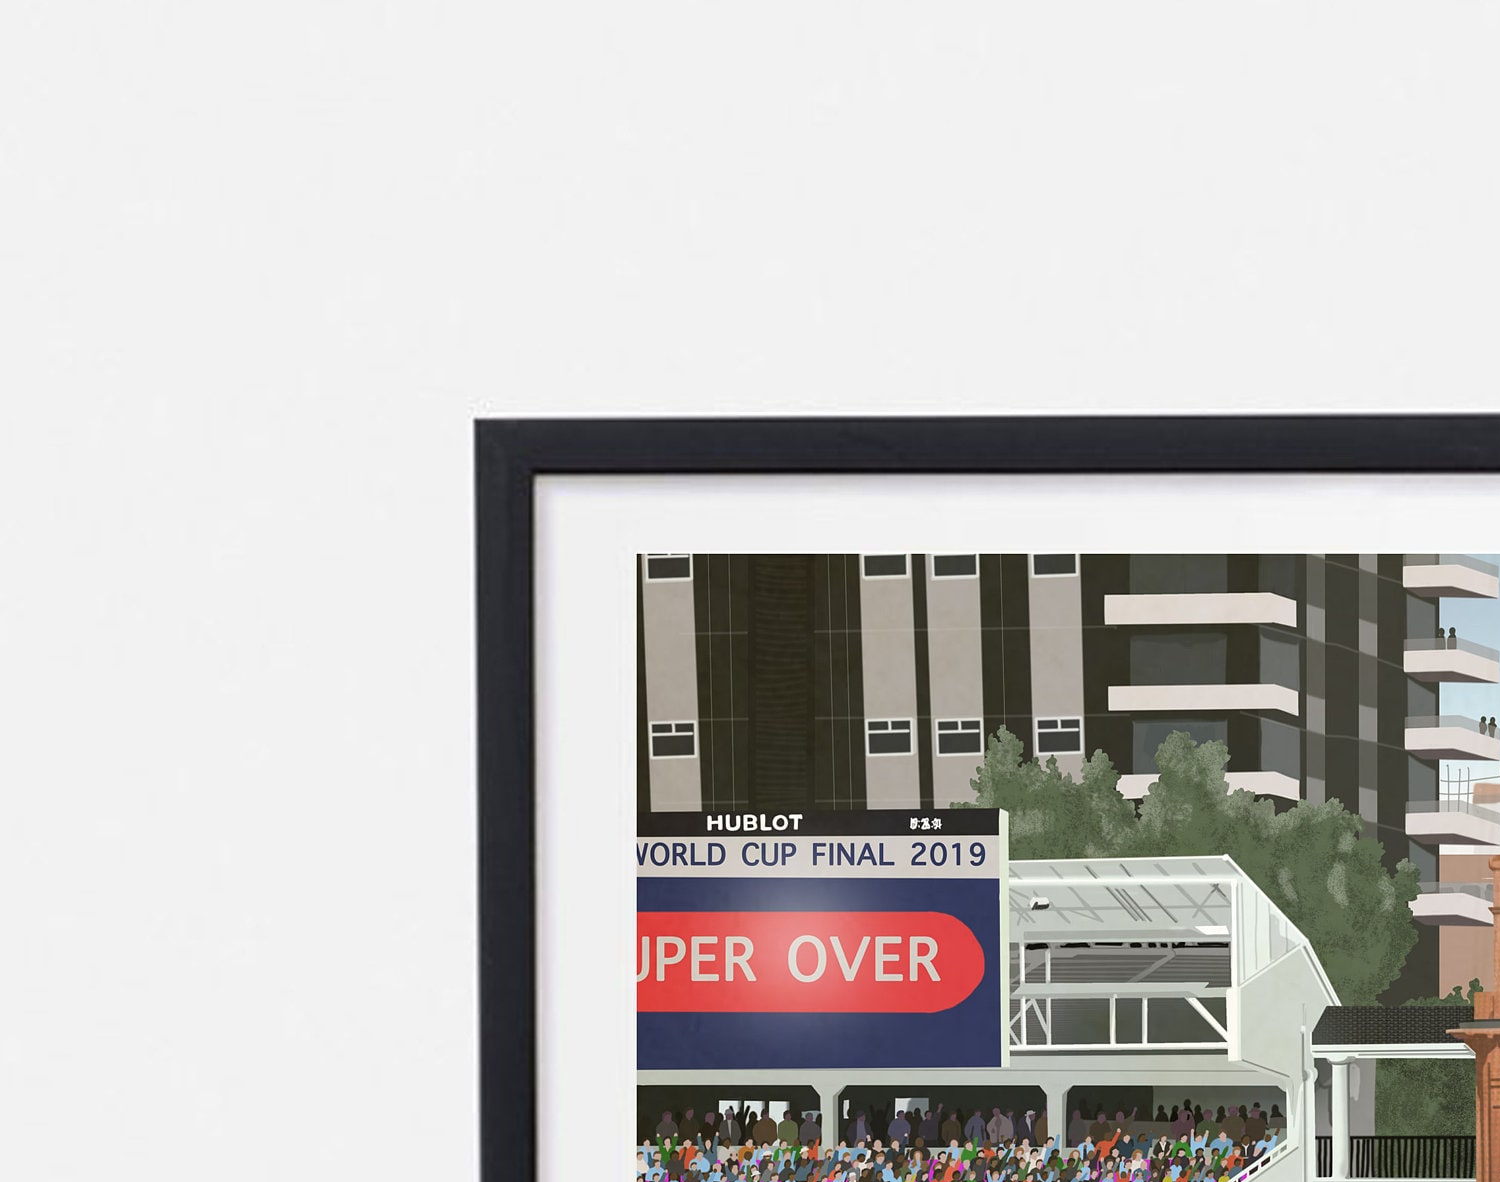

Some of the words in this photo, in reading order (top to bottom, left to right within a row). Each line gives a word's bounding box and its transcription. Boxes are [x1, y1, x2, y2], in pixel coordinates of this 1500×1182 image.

[706, 814, 803, 831] HUBLOT
[741, 842, 797, 866] CUP
[812, 843, 895, 866] FINAL
[911, 842, 986, 867] 2019
[788, 935, 941, 983] OVER
